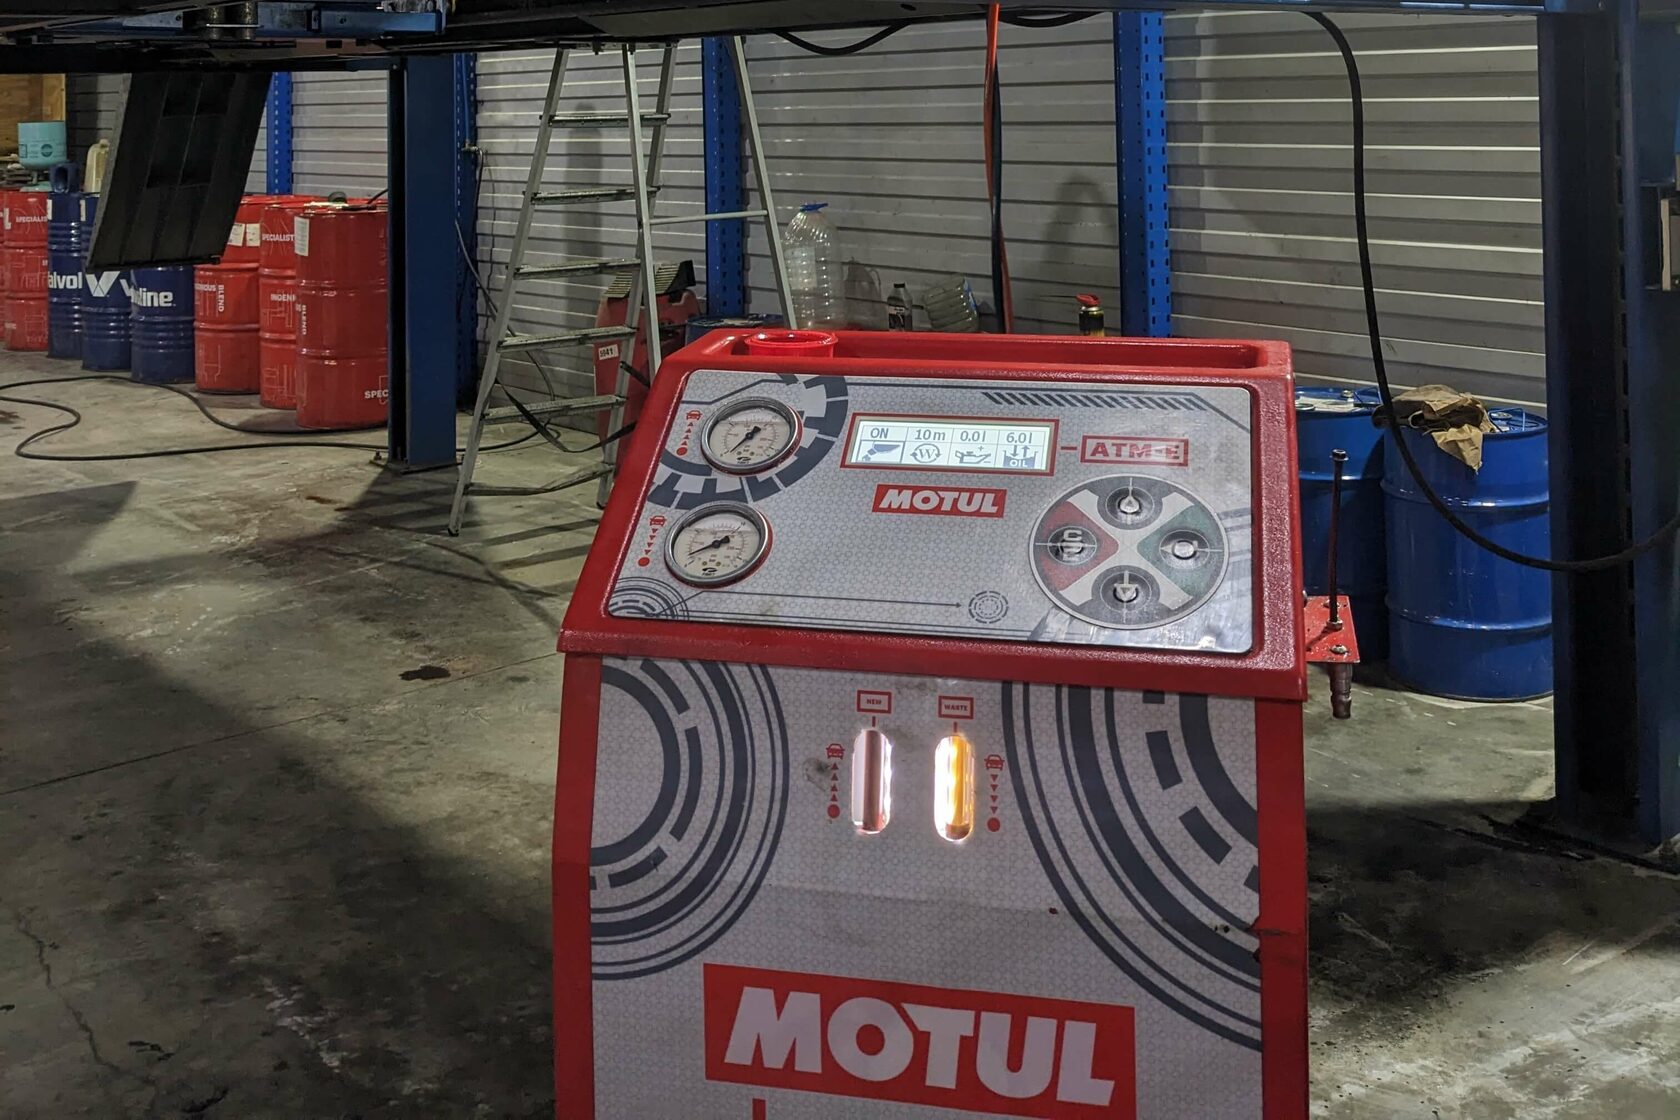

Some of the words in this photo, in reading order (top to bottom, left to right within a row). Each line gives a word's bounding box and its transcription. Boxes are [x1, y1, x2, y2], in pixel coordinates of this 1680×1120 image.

[870, 427, 889, 440] ON
[1009, 459, 1029, 468] OIL
[878, 489, 1001, 514] MOTUL
[723, 985, 1116, 1107] MOTUL
